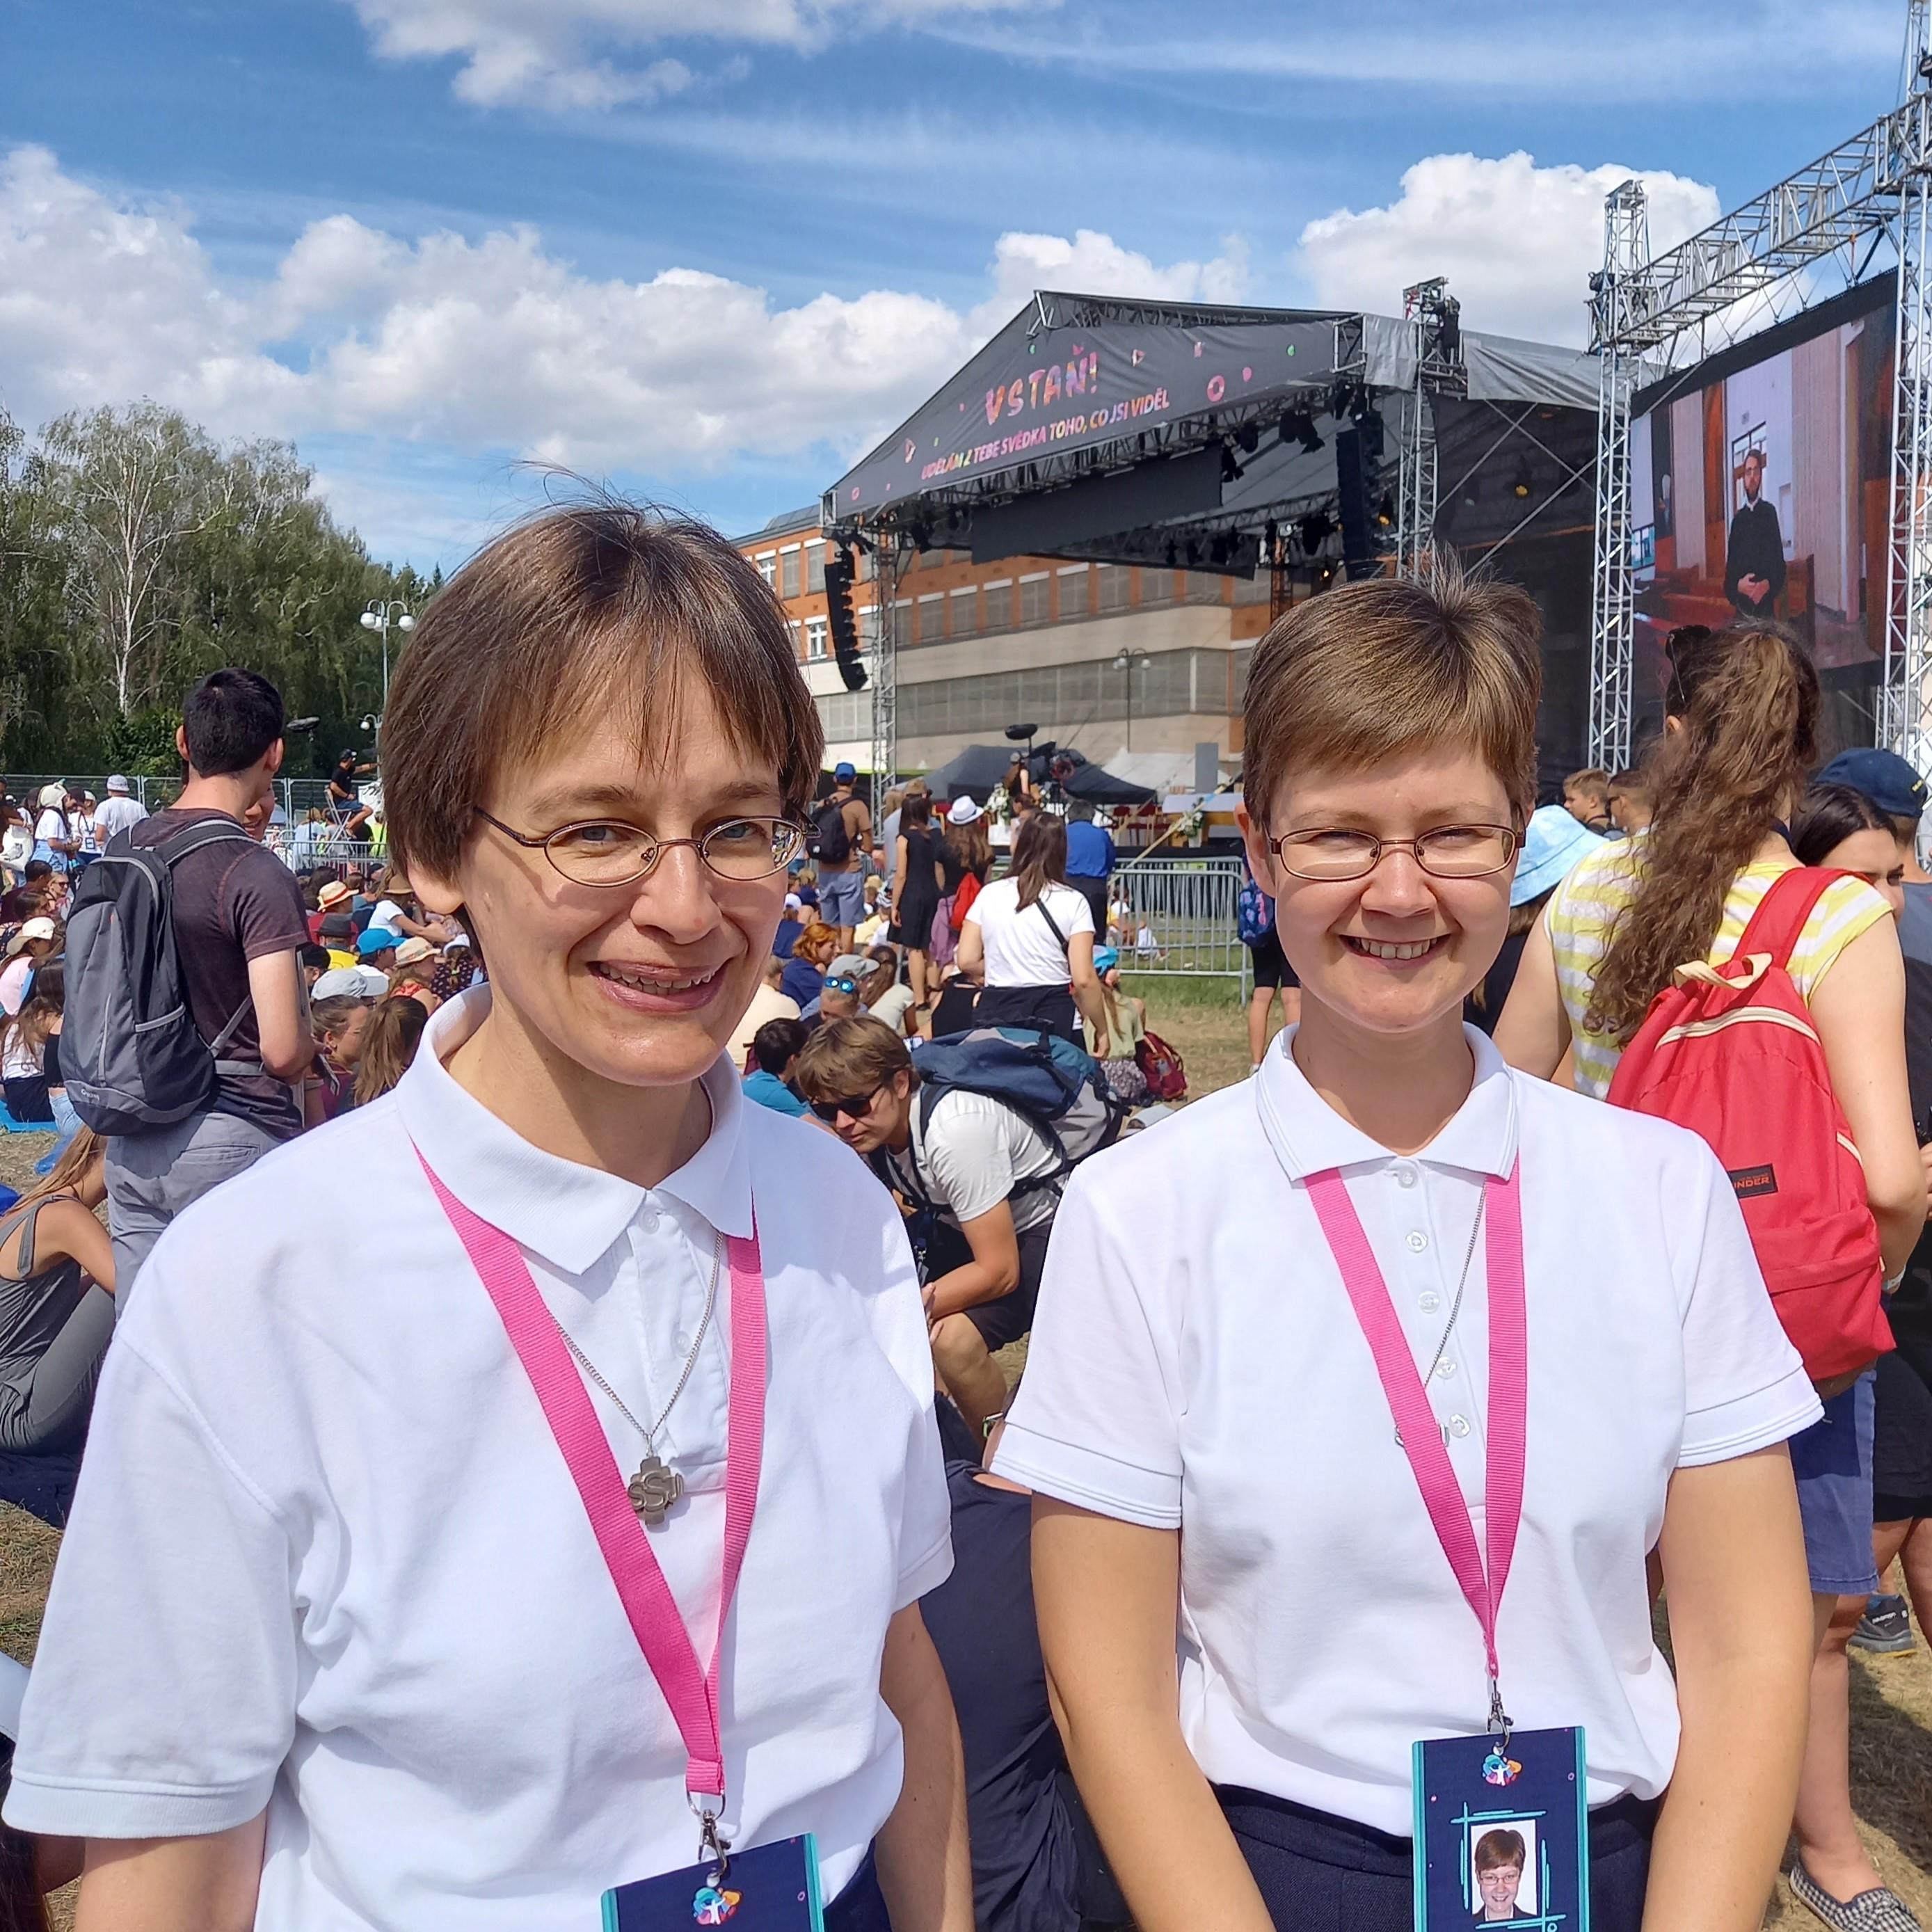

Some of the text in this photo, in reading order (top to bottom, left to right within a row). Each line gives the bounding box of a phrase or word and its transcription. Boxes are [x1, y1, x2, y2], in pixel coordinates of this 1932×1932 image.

[985, 344, 1098, 426] VSTAŇ!
[963, 448, 973, 467] Z
[974, 440, 1001, 465] TEBE
[1050, 415, 1088, 441] TOHO,
[1089, 408, 1109, 429] CO
[1109, 401, 1129, 424] JSI
[1131, 387, 1170, 417] VIDĚL
